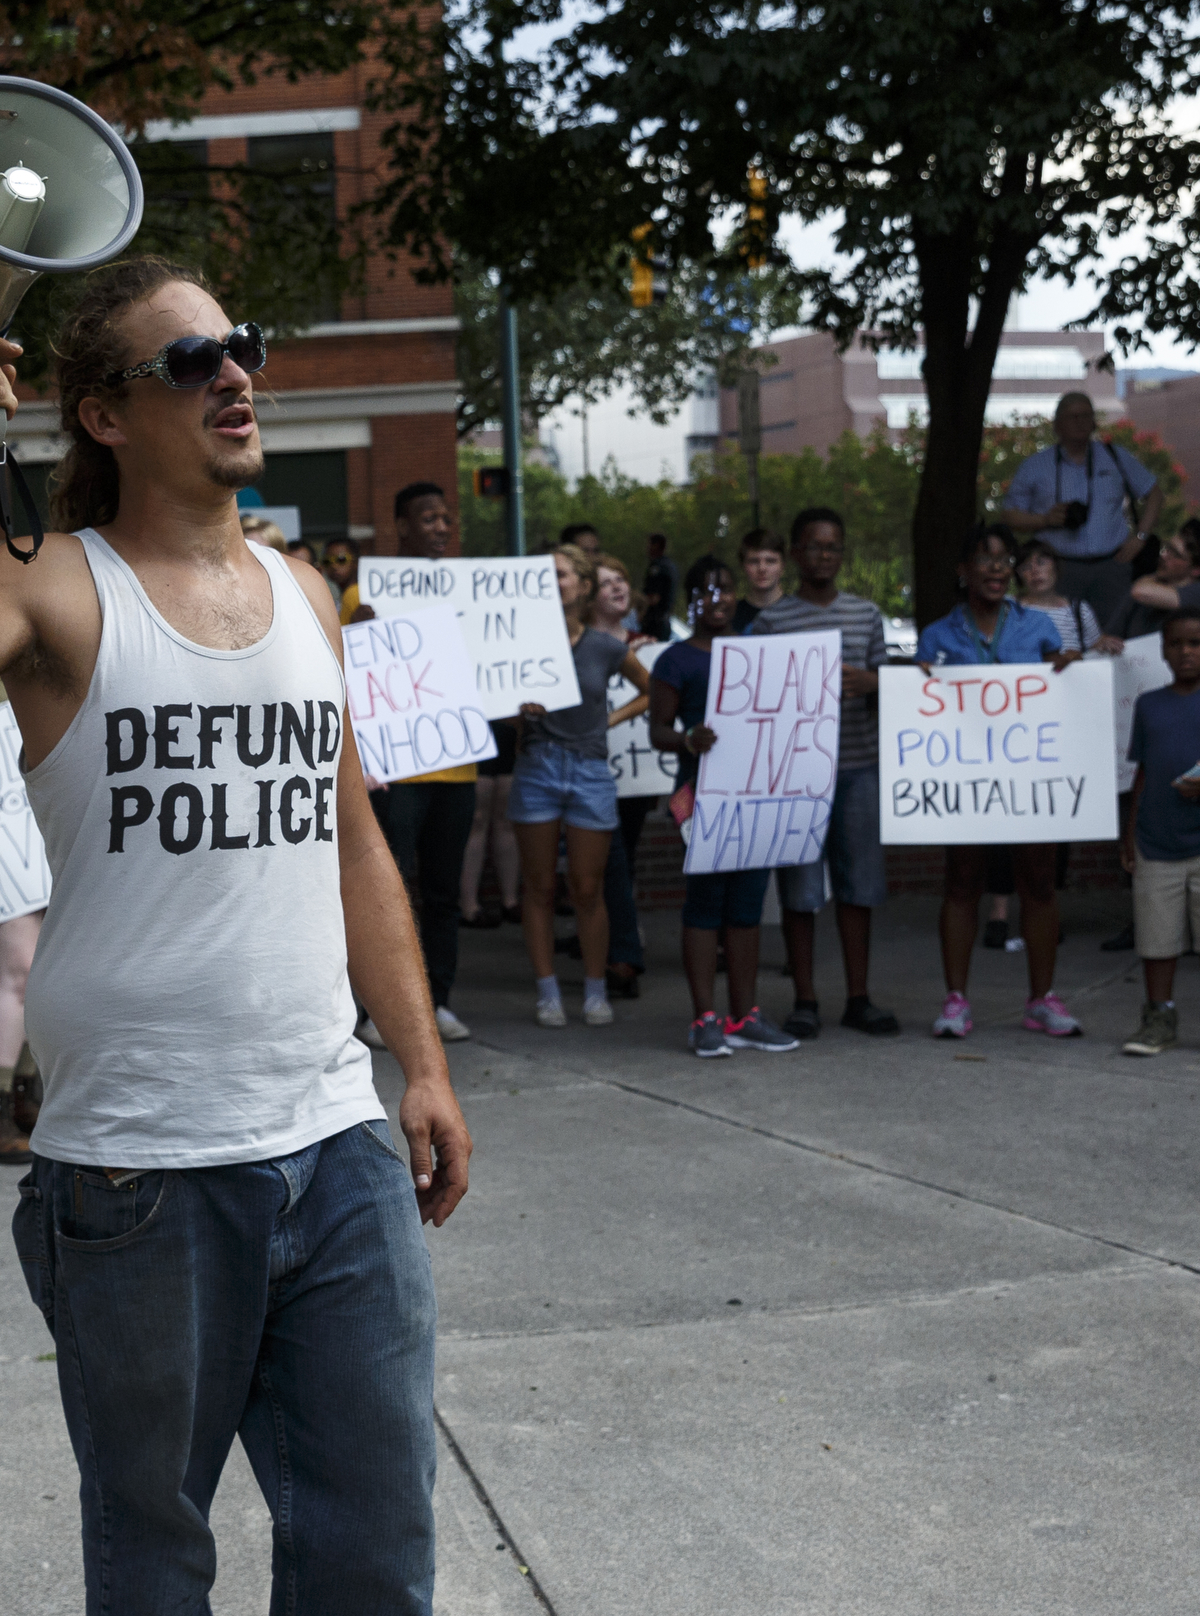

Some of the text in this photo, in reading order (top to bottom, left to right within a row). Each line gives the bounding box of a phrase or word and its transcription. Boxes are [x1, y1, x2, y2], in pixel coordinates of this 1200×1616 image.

[368, 566, 557, 602] DEFUND POLICE
[345, 617, 423, 669] END
[483, 606, 517, 642] IN
[475, 656, 562, 694] ITIES
[715, 644, 843, 717] BLACK
[917, 674, 1048, 717] STOP
[104, 699, 341, 777] DEFUND
[356, 705, 491, 777] NHOOD
[699, 713, 837, 800] LIVES
[896, 721, 1061, 767] POLICE
[106, 774, 334, 857] POLICE
[891, 775, 1087, 819] BRUTALITY
[683, 795, 831, 874] MATTER
